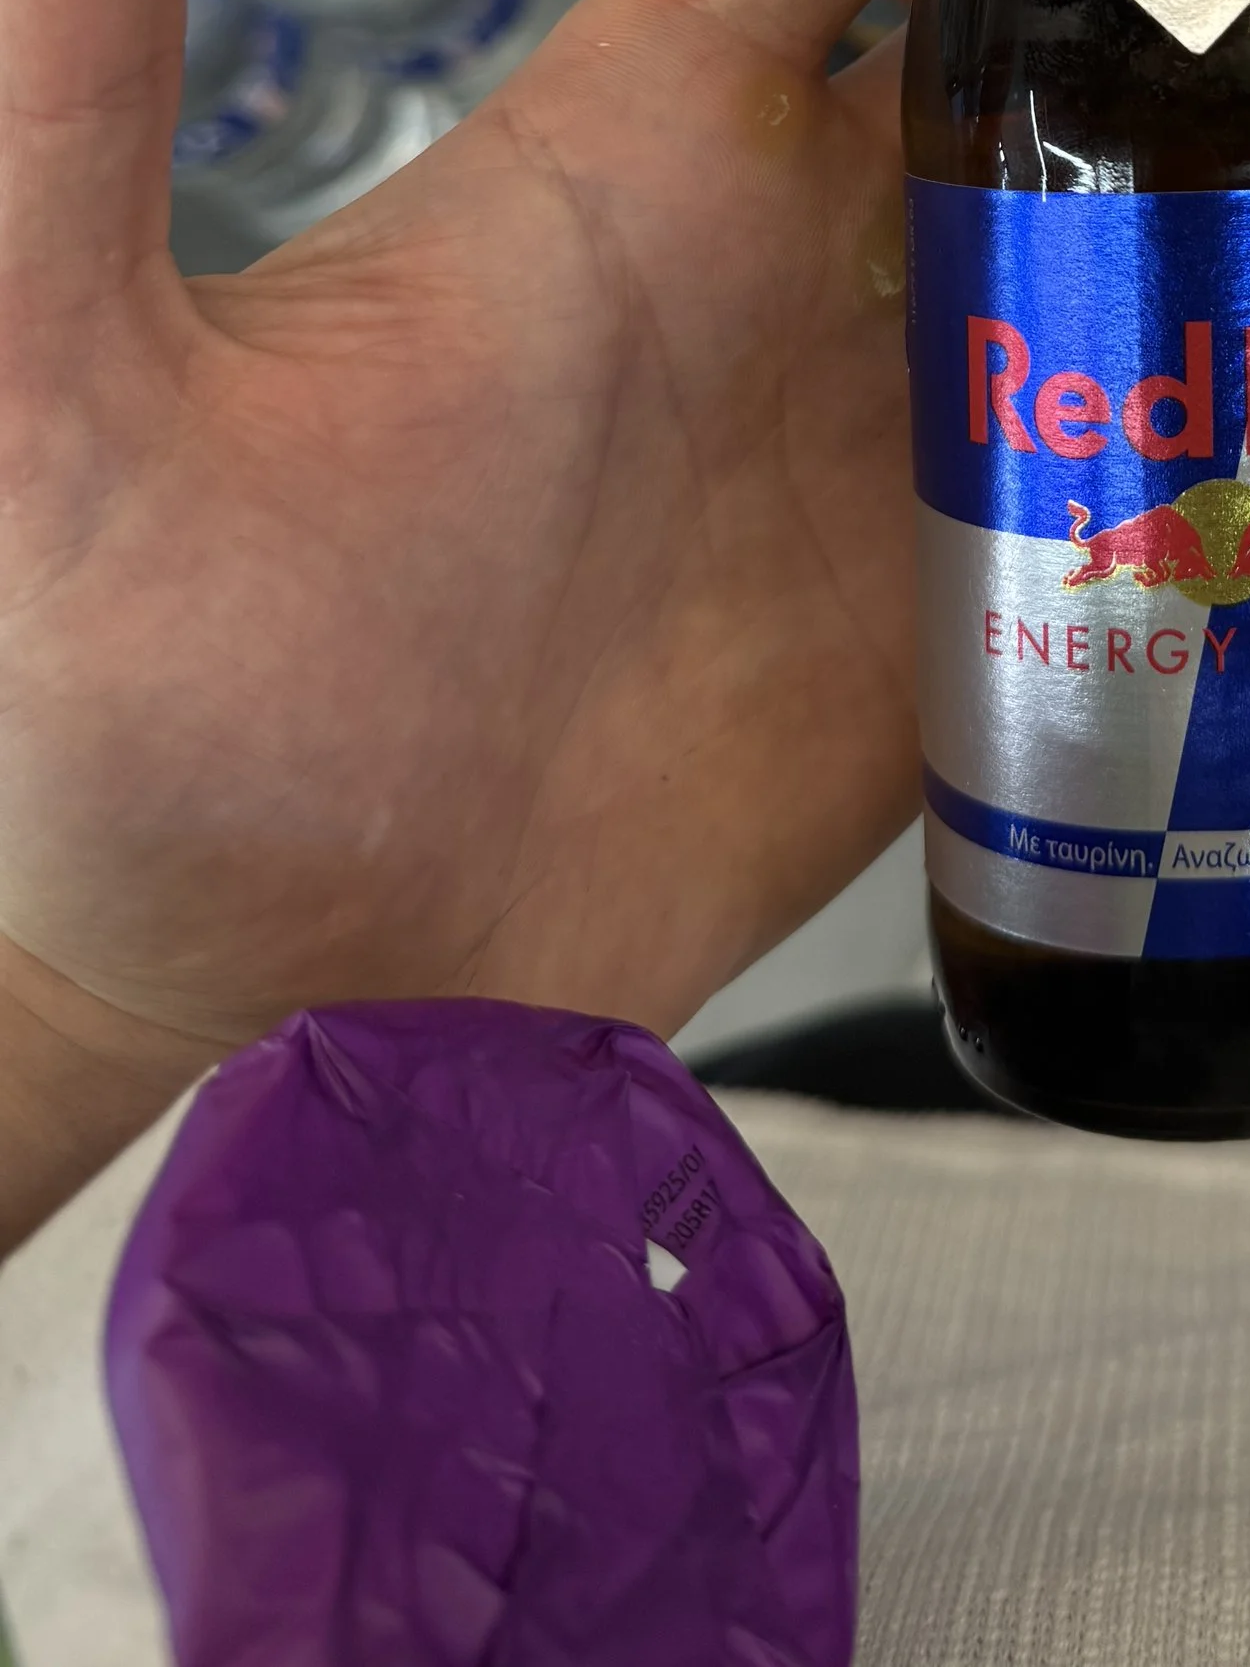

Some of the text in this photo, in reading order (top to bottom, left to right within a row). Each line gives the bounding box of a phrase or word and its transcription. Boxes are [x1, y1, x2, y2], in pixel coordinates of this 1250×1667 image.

[967, 315, 1215, 461] Red
[984, 609, 1237, 676] ENERGY
[1009, 823, 1041, 856] Με
[1049, 837, 1154, 877] ταυρίνη.
